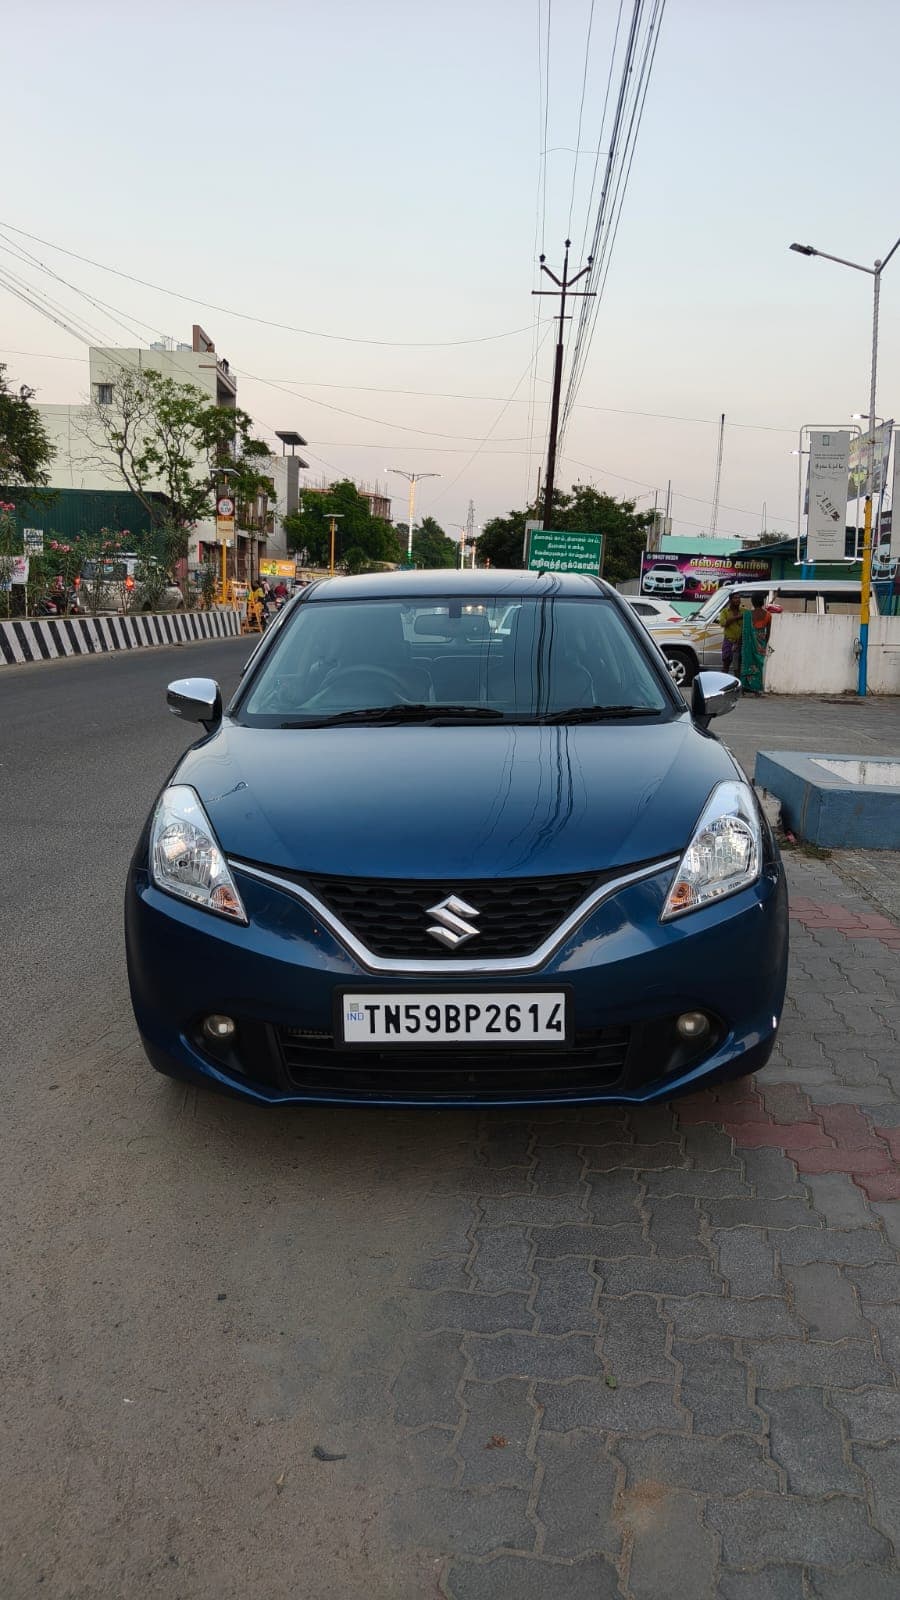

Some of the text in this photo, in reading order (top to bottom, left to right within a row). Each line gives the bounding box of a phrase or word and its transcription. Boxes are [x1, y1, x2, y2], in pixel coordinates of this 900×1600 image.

[700, 581, 719, 592] SM
[347, 1012, 365, 1021] IND
[364, 1003, 562, 1034] TN59BP2614
